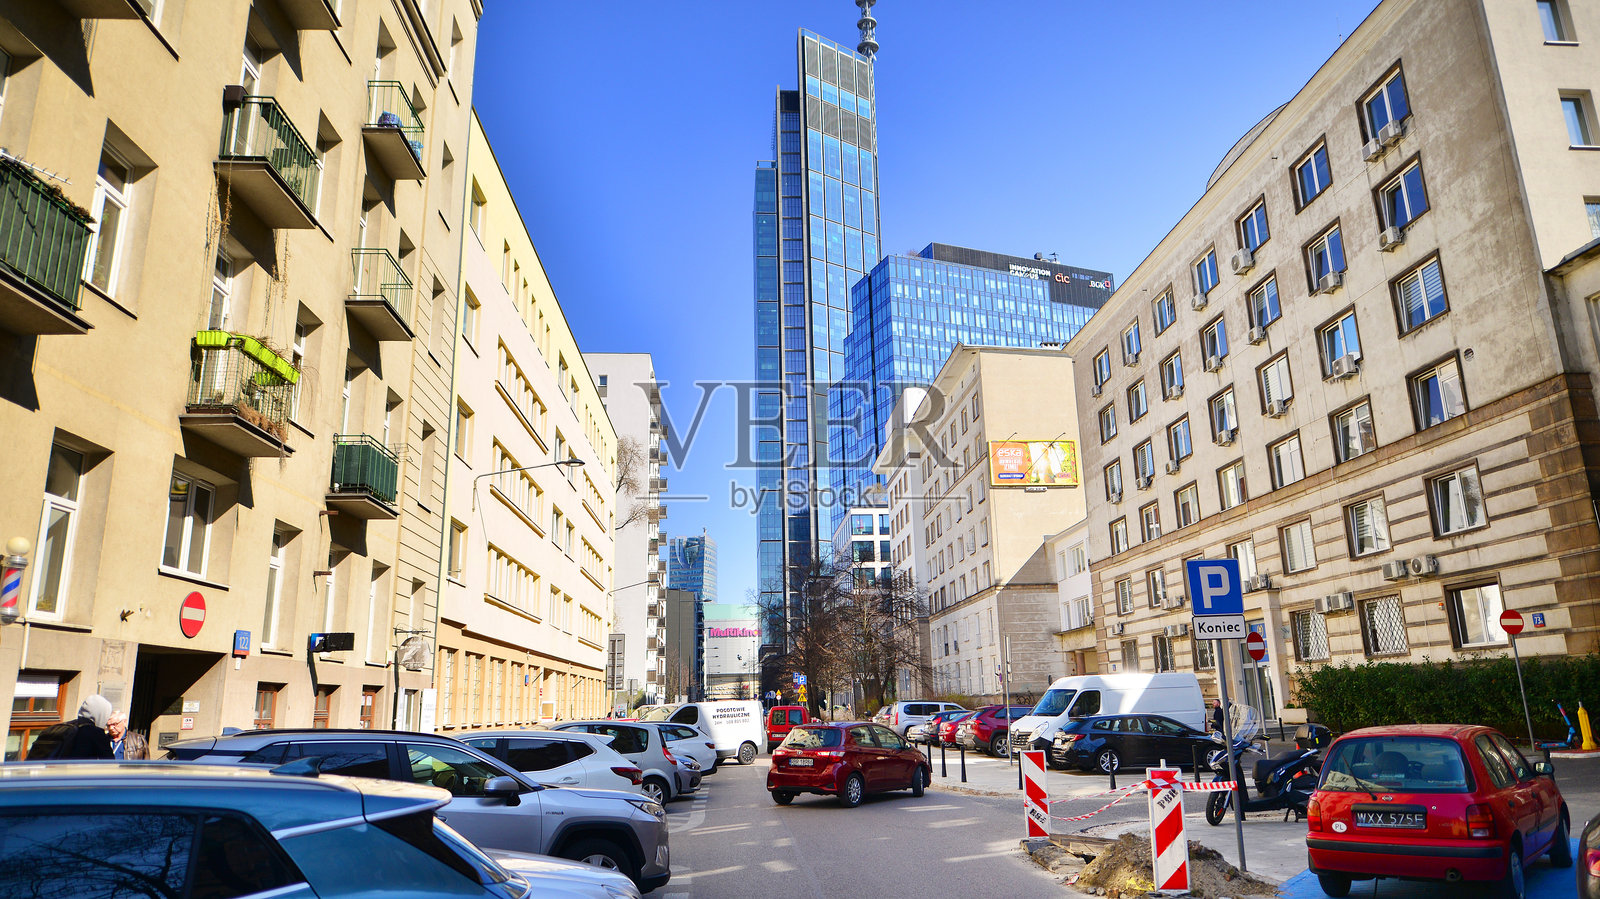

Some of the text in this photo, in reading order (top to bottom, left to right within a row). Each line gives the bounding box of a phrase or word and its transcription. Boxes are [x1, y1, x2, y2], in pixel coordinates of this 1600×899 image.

[1009, 263, 1051, 277] INNOVATION
[1198, 565, 1231, 609] P
[709, 627, 761, 637] Multikino
[1197, 621, 1241, 634] Koniec
[239, 636, 248, 649] 122
[1357, 812, 1383, 825] WXX
